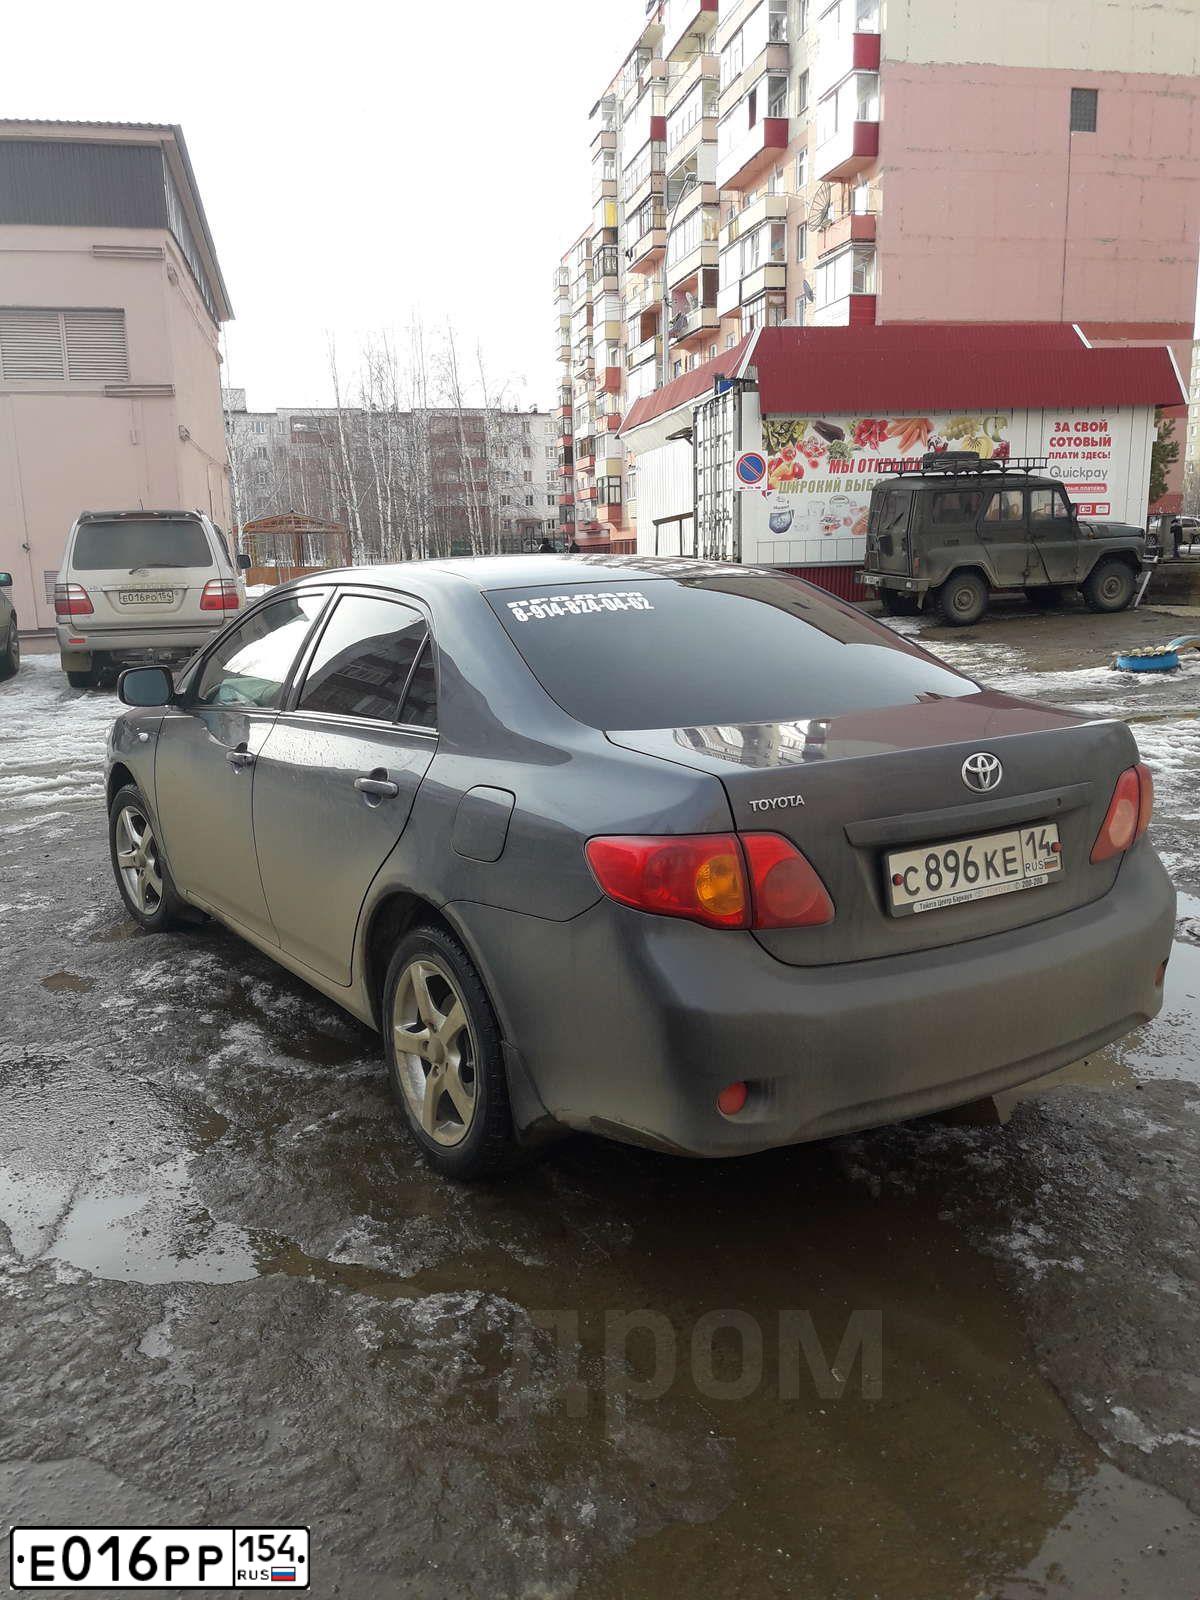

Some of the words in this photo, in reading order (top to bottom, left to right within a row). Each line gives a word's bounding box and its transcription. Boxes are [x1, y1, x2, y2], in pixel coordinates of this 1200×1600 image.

[1054, 421, 1070, 432] ЗА
[1074, 419, 1108, 432] СВОЙ
[1049, 434, 1112, 447] СОТОВЫЙ
[1049, 451, 1079, 460] ПЛАТИ
[1081, 451, 1111, 460] ЗДЕСЬ!
[829, 458, 855, 474] МЫ
[1049, 465, 1108, 481] Quickpay
[778, 476, 842, 495] ШИРОКИЙ
[506, 591, 643, 609] ПРОДАМ
[750, 795, 805, 812] TOYOTA
[1024, 828, 1050, 859] 14
[1025, 861, 1044, 872] RUS
